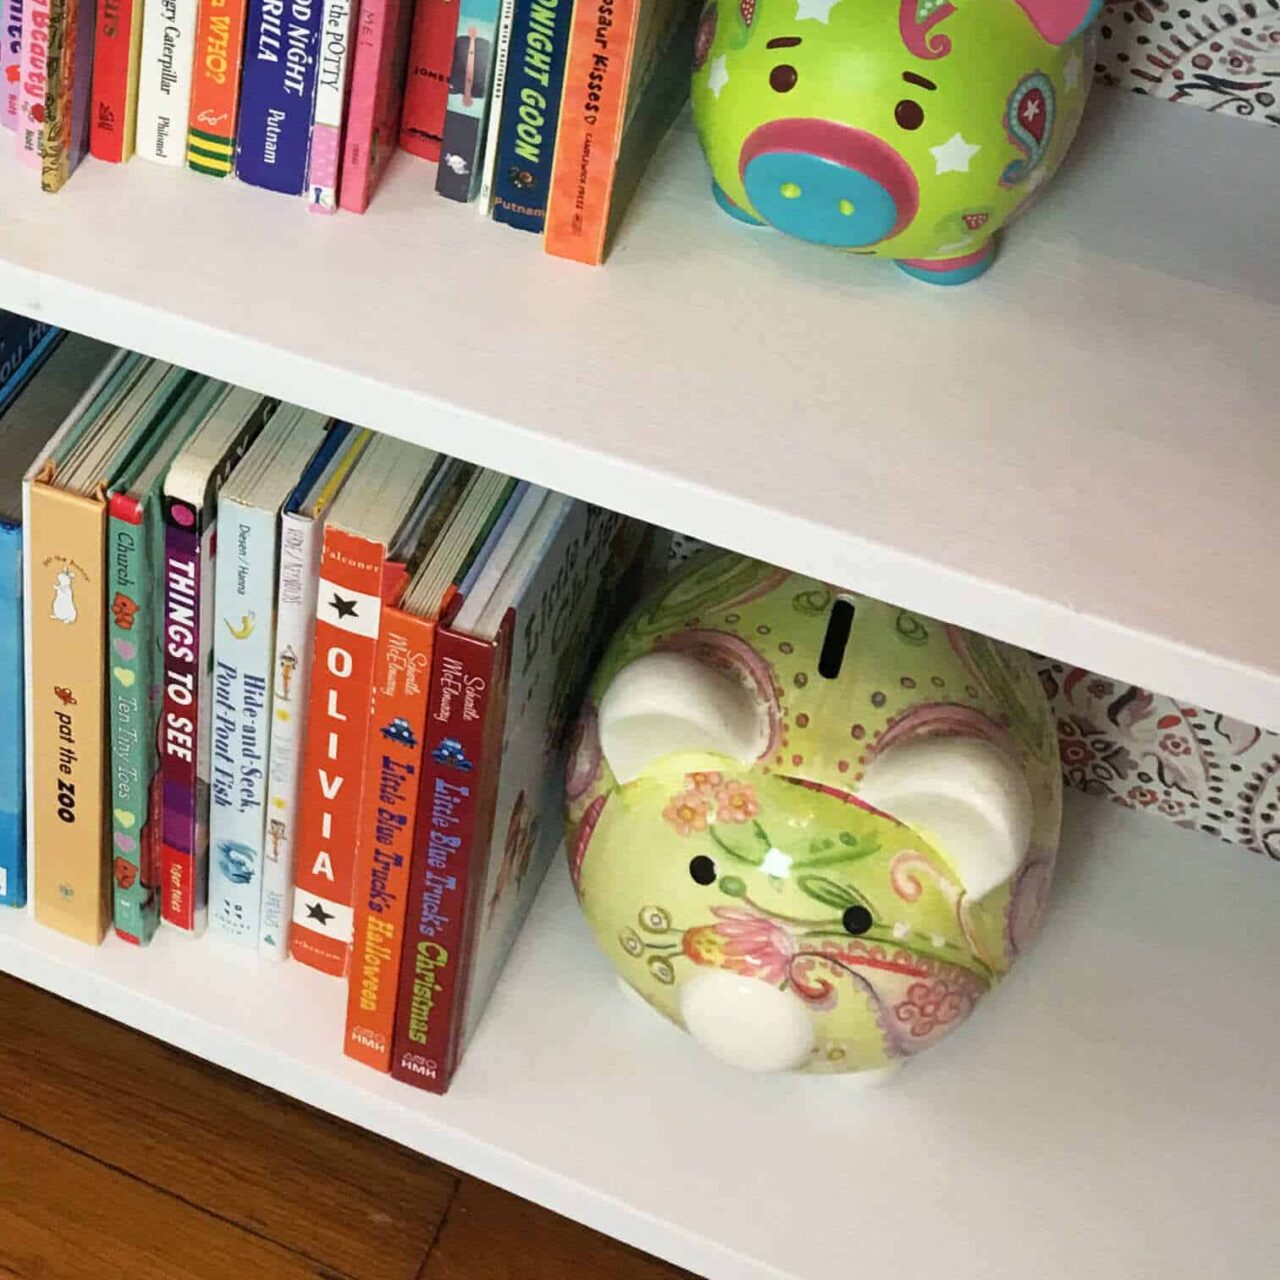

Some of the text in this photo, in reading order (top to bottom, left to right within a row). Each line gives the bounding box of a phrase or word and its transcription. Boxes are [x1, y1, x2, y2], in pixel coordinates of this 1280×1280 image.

[327, 4, 348, 27] the
[157, 26, 180, 95] Caterpillar
[204, 15, 231, 85] WHO?
[583, 53, 610, 114] Kisses
[263, 108, 287, 164] Putnam
[514, 87, 547, 164] GOON
[494, 195, 546, 219] Putnam
[116, 531, 135, 587] Church
[166, 559, 196, 764] THINGS TO SEE
[54, 709, 78, 775] pat the
[117, 696, 138, 730] Ten
[212, 659, 237, 808] Pout-Pout Fish
[311, 645, 353, 882] OLIVIA
[360, 754, 415, 1012] Little Blue Truck's Halloween
[407, 777, 470, 1045] Little Blue Truck's Christmas
[400, 1058, 438, 1082] HMH
